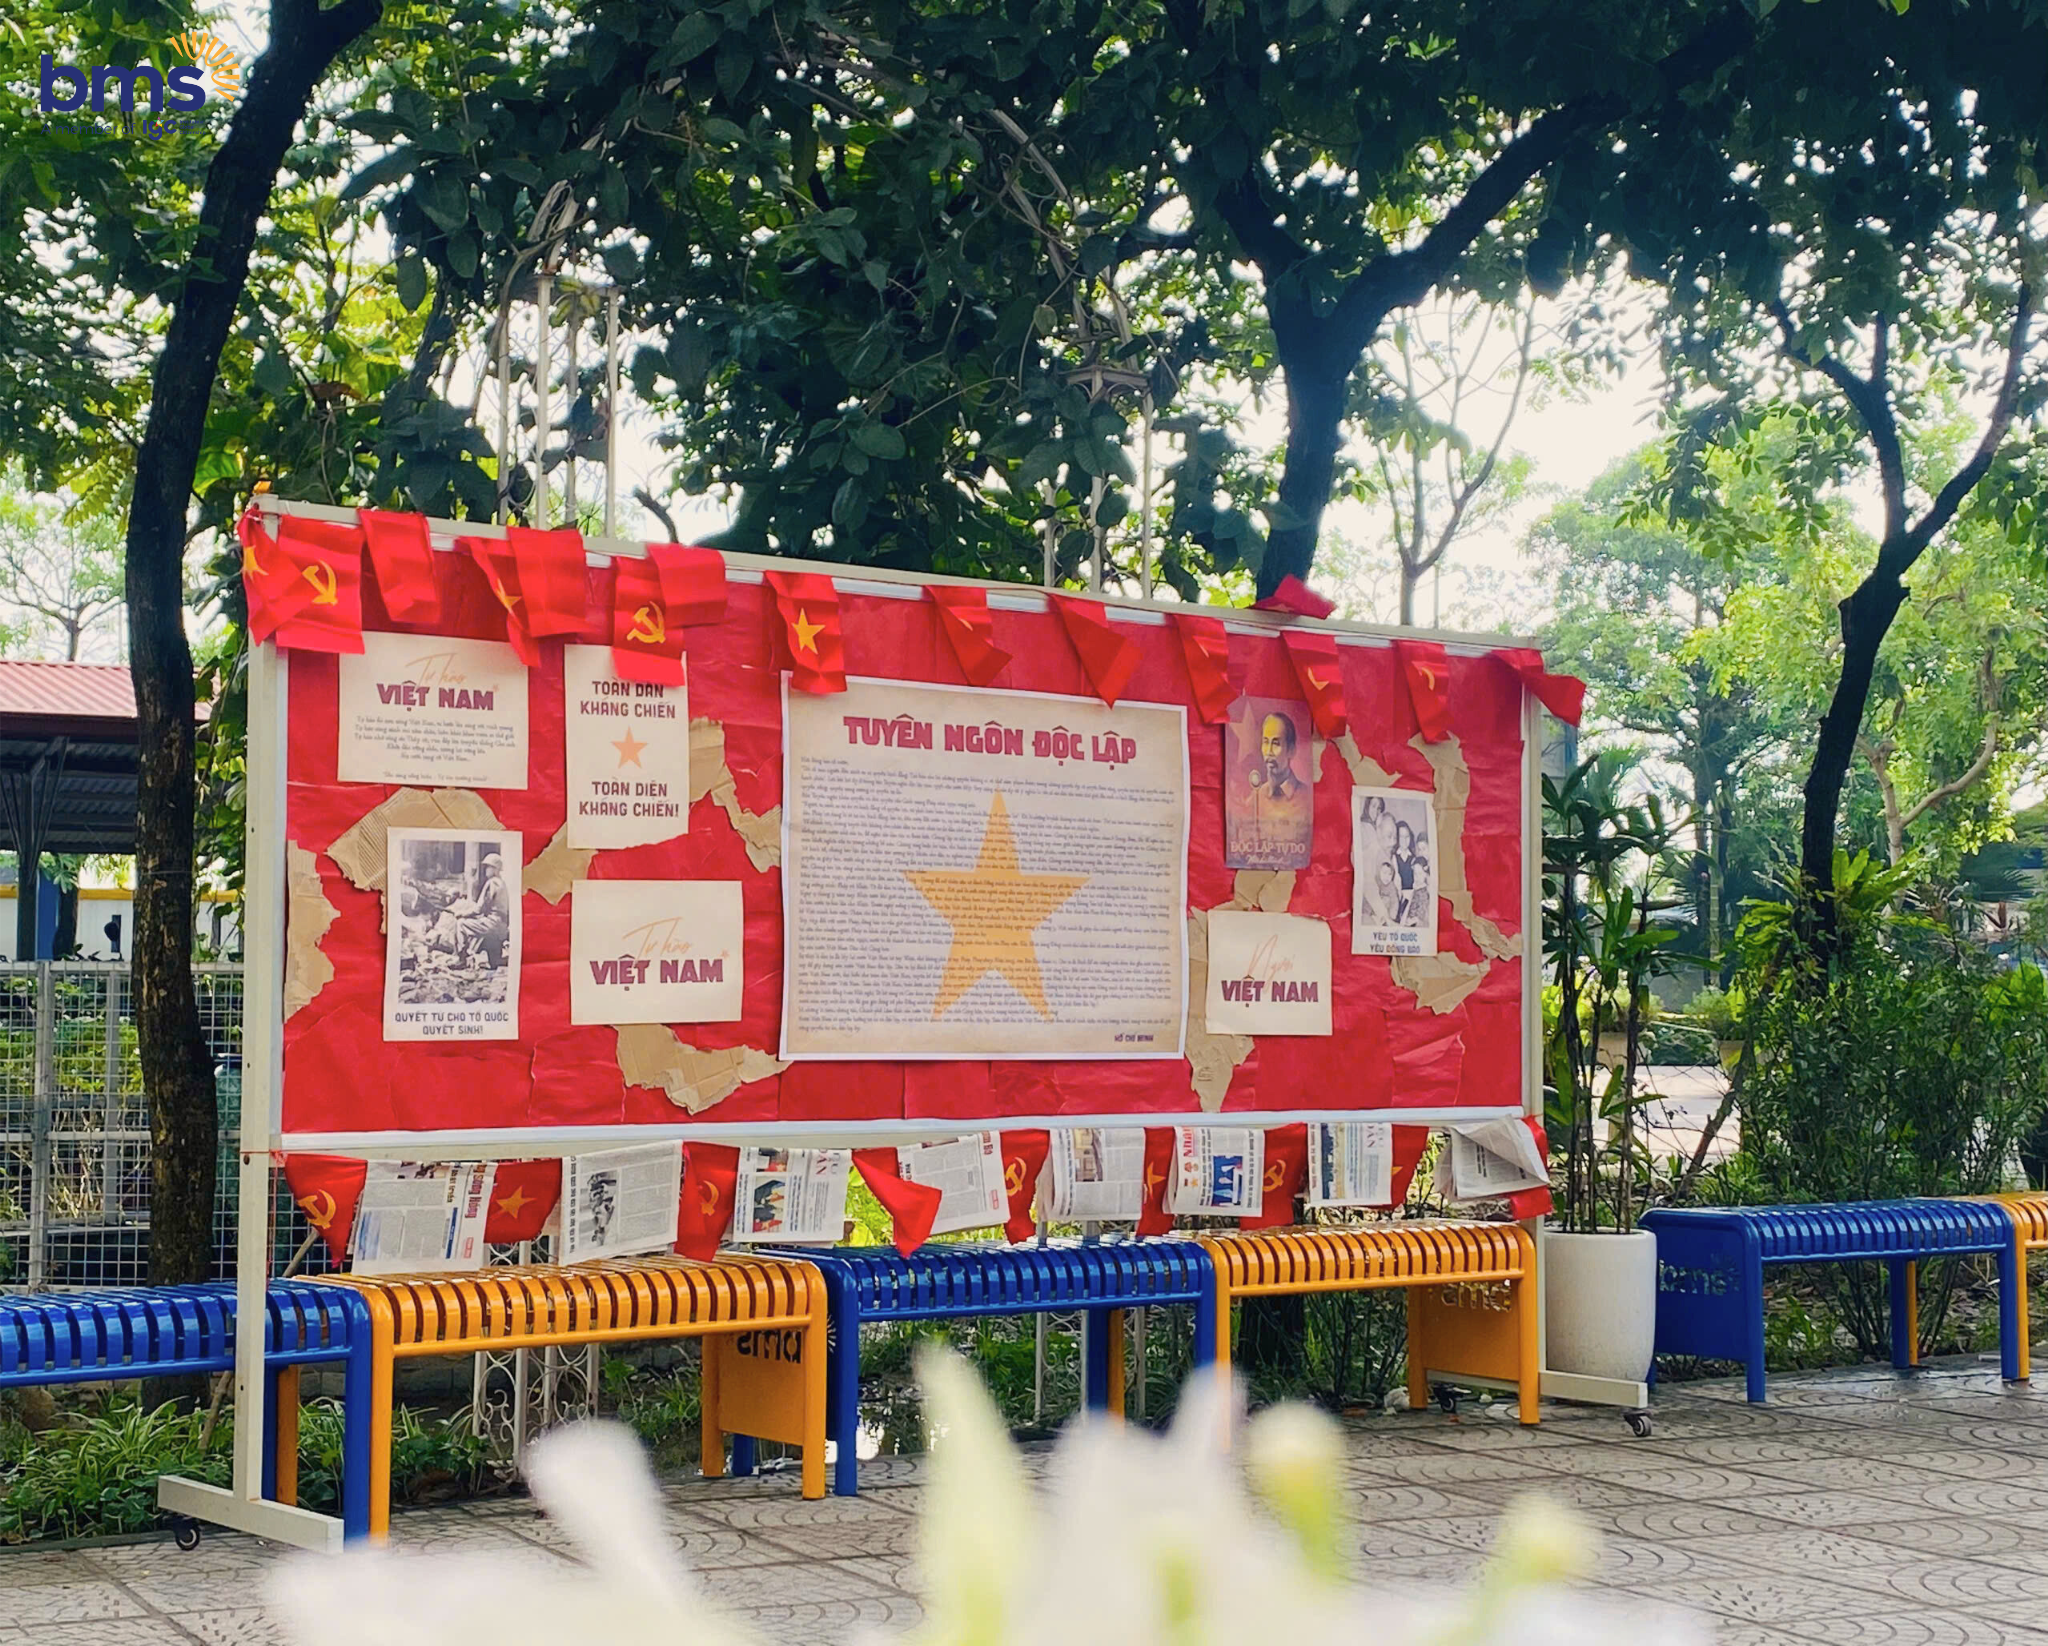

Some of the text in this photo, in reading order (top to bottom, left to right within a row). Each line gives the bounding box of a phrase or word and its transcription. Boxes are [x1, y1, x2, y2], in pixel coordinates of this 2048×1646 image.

[376, 680, 494, 712] VIỆT NAM
[592, 676, 631, 697] TOÀN
[580, 697, 676, 719] KHÁNG CHIẾN
[843, 713, 1137, 771] TUYÊN NGÔN ĐỘC LẬP
[592, 776, 668, 801] TOÀN DIỆN
[579, 797, 679, 818] KHÁNG CHIẾN!
[590, 954, 723, 991] VIỆT NAM
[1221, 974, 1319, 1008] VIỆT NAM
[447, 1012, 466, 1022] CHO
